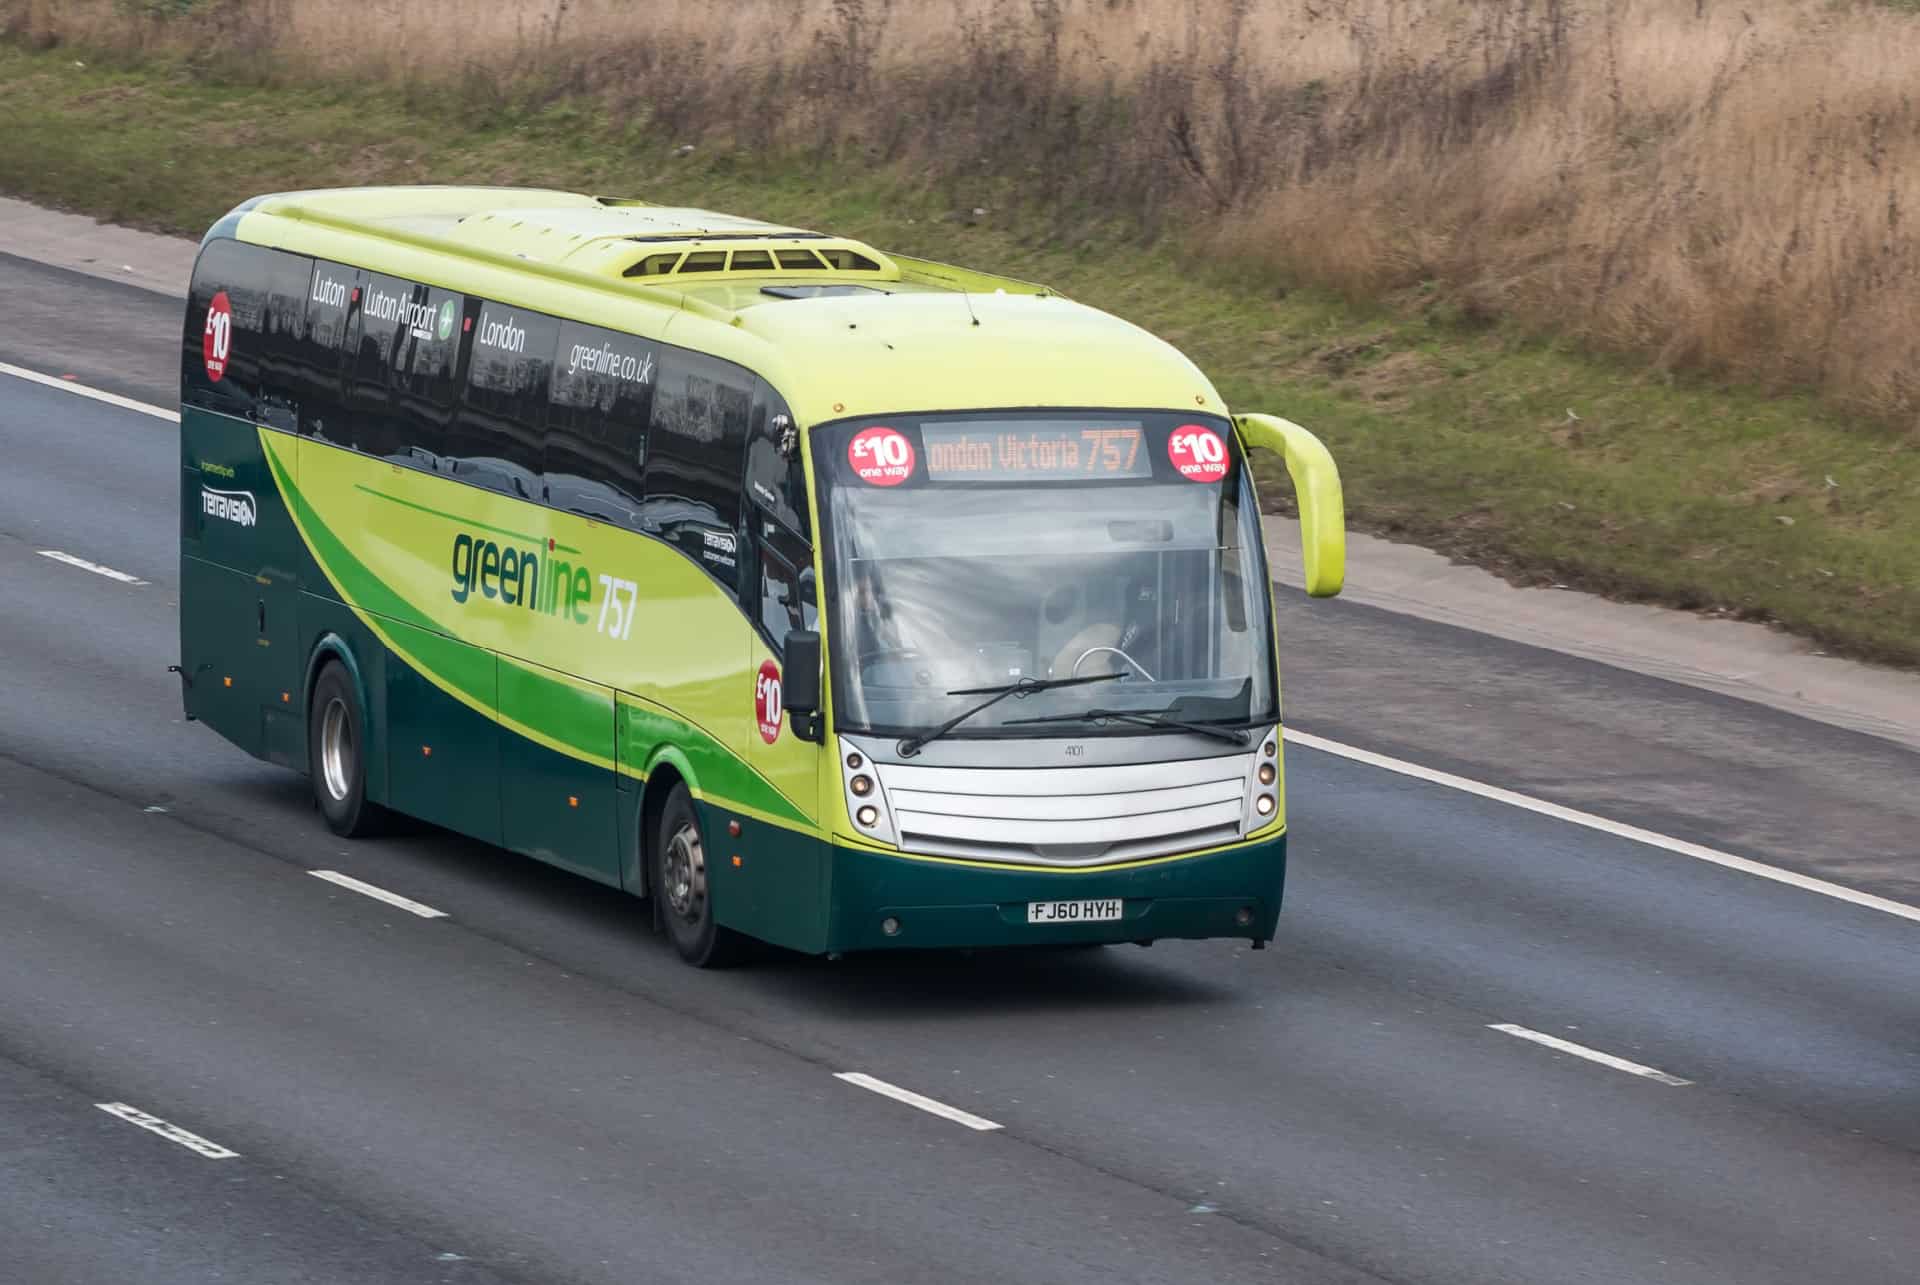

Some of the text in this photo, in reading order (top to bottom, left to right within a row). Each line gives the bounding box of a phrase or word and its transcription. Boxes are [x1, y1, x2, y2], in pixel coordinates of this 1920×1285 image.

[312, 270, 345, 308] Luton
[364, 284, 437, 334] Luton Airport
[205, 306, 230, 360] £10
[480, 312, 525, 353] London
[568, 342, 652, 384] greenline.co.uk
[853, 434, 909, 467] £10
[927, 434, 993, 472] ondon
[1081, 428, 1143, 472] 757
[1172, 432, 1224, 464] £10
[860, 465, 909, 479] one way
[1180, 463, 1226, 476] one way
[451, 533, 639, 641] greenline 757
[757, 672, 782, 726] £10
[1065, 745, 1084, 757] 4101
[1034, 901, 1116, 920] FJ60 HYH
